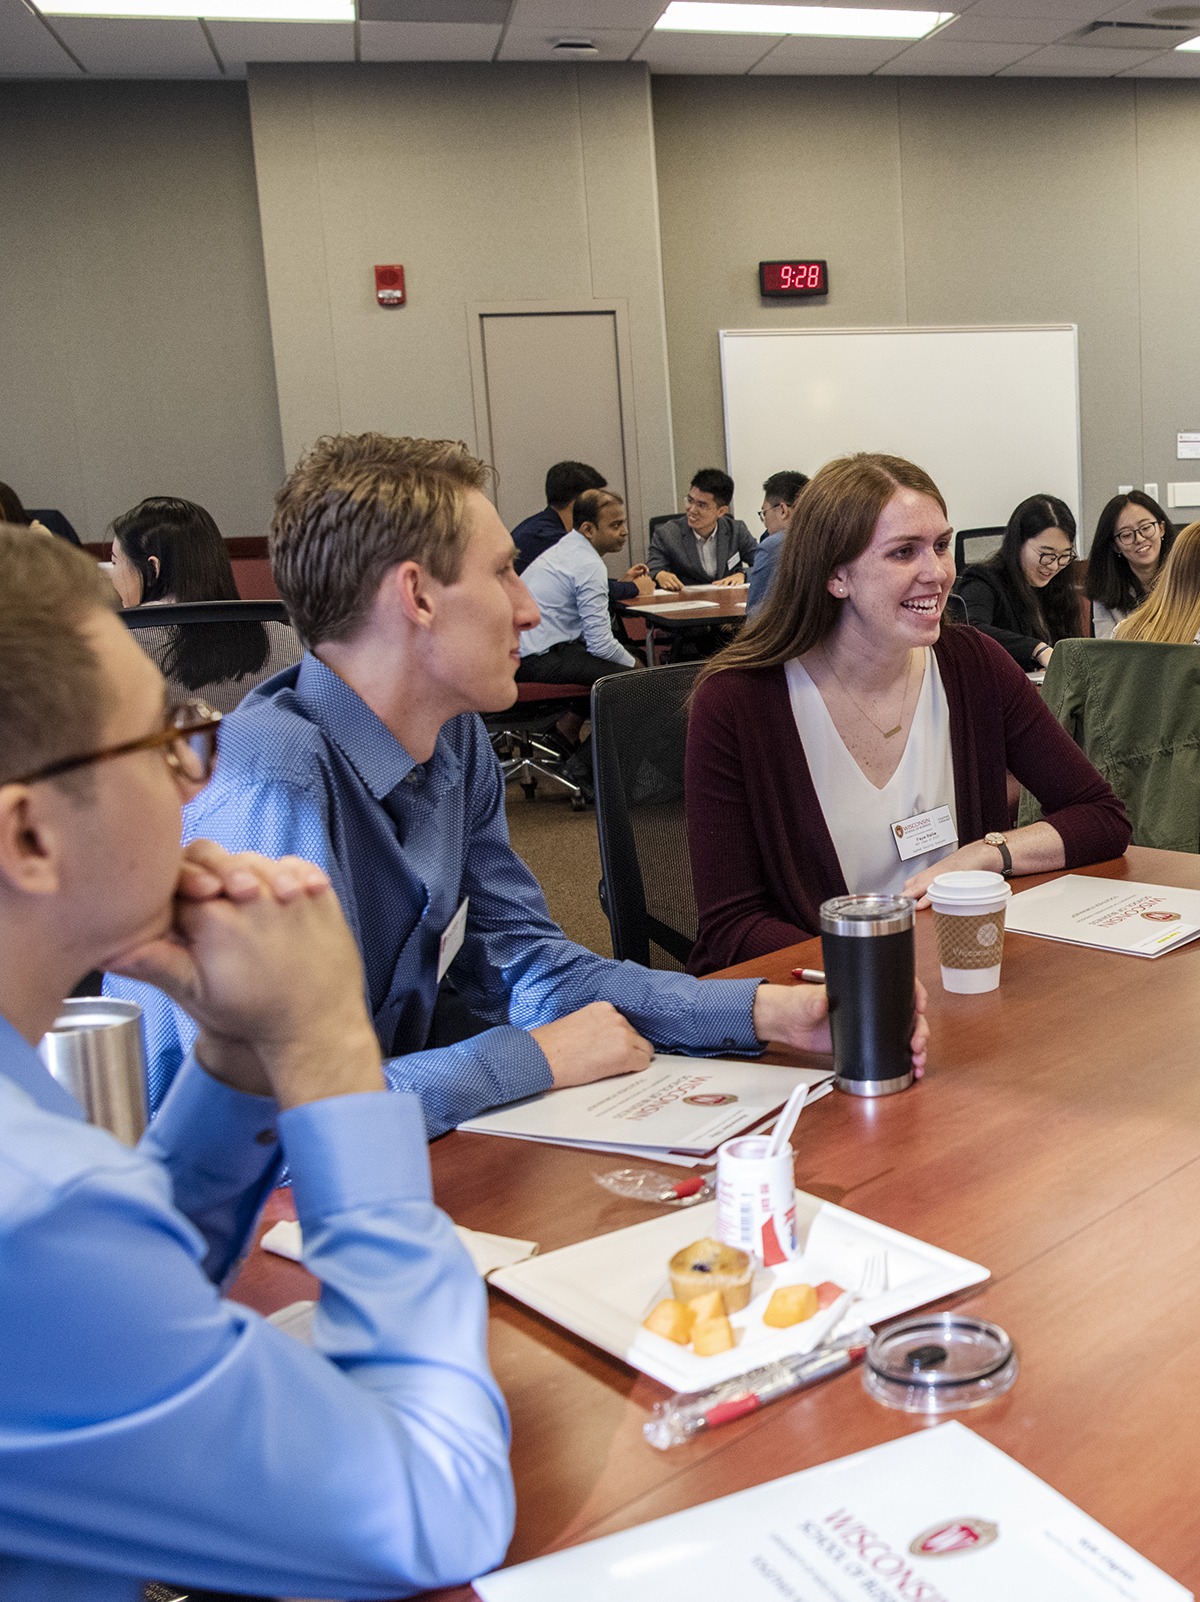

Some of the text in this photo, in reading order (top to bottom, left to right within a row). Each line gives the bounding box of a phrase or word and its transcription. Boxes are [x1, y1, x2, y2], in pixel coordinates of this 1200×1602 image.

[780, 265, 820, 289] 9:28
[904, 818, 931, 831] WISCONSIN
[1097, 897, 1168, 928] WISCONSIN
[626, 1075, 714, 1121] WISCONSIN
